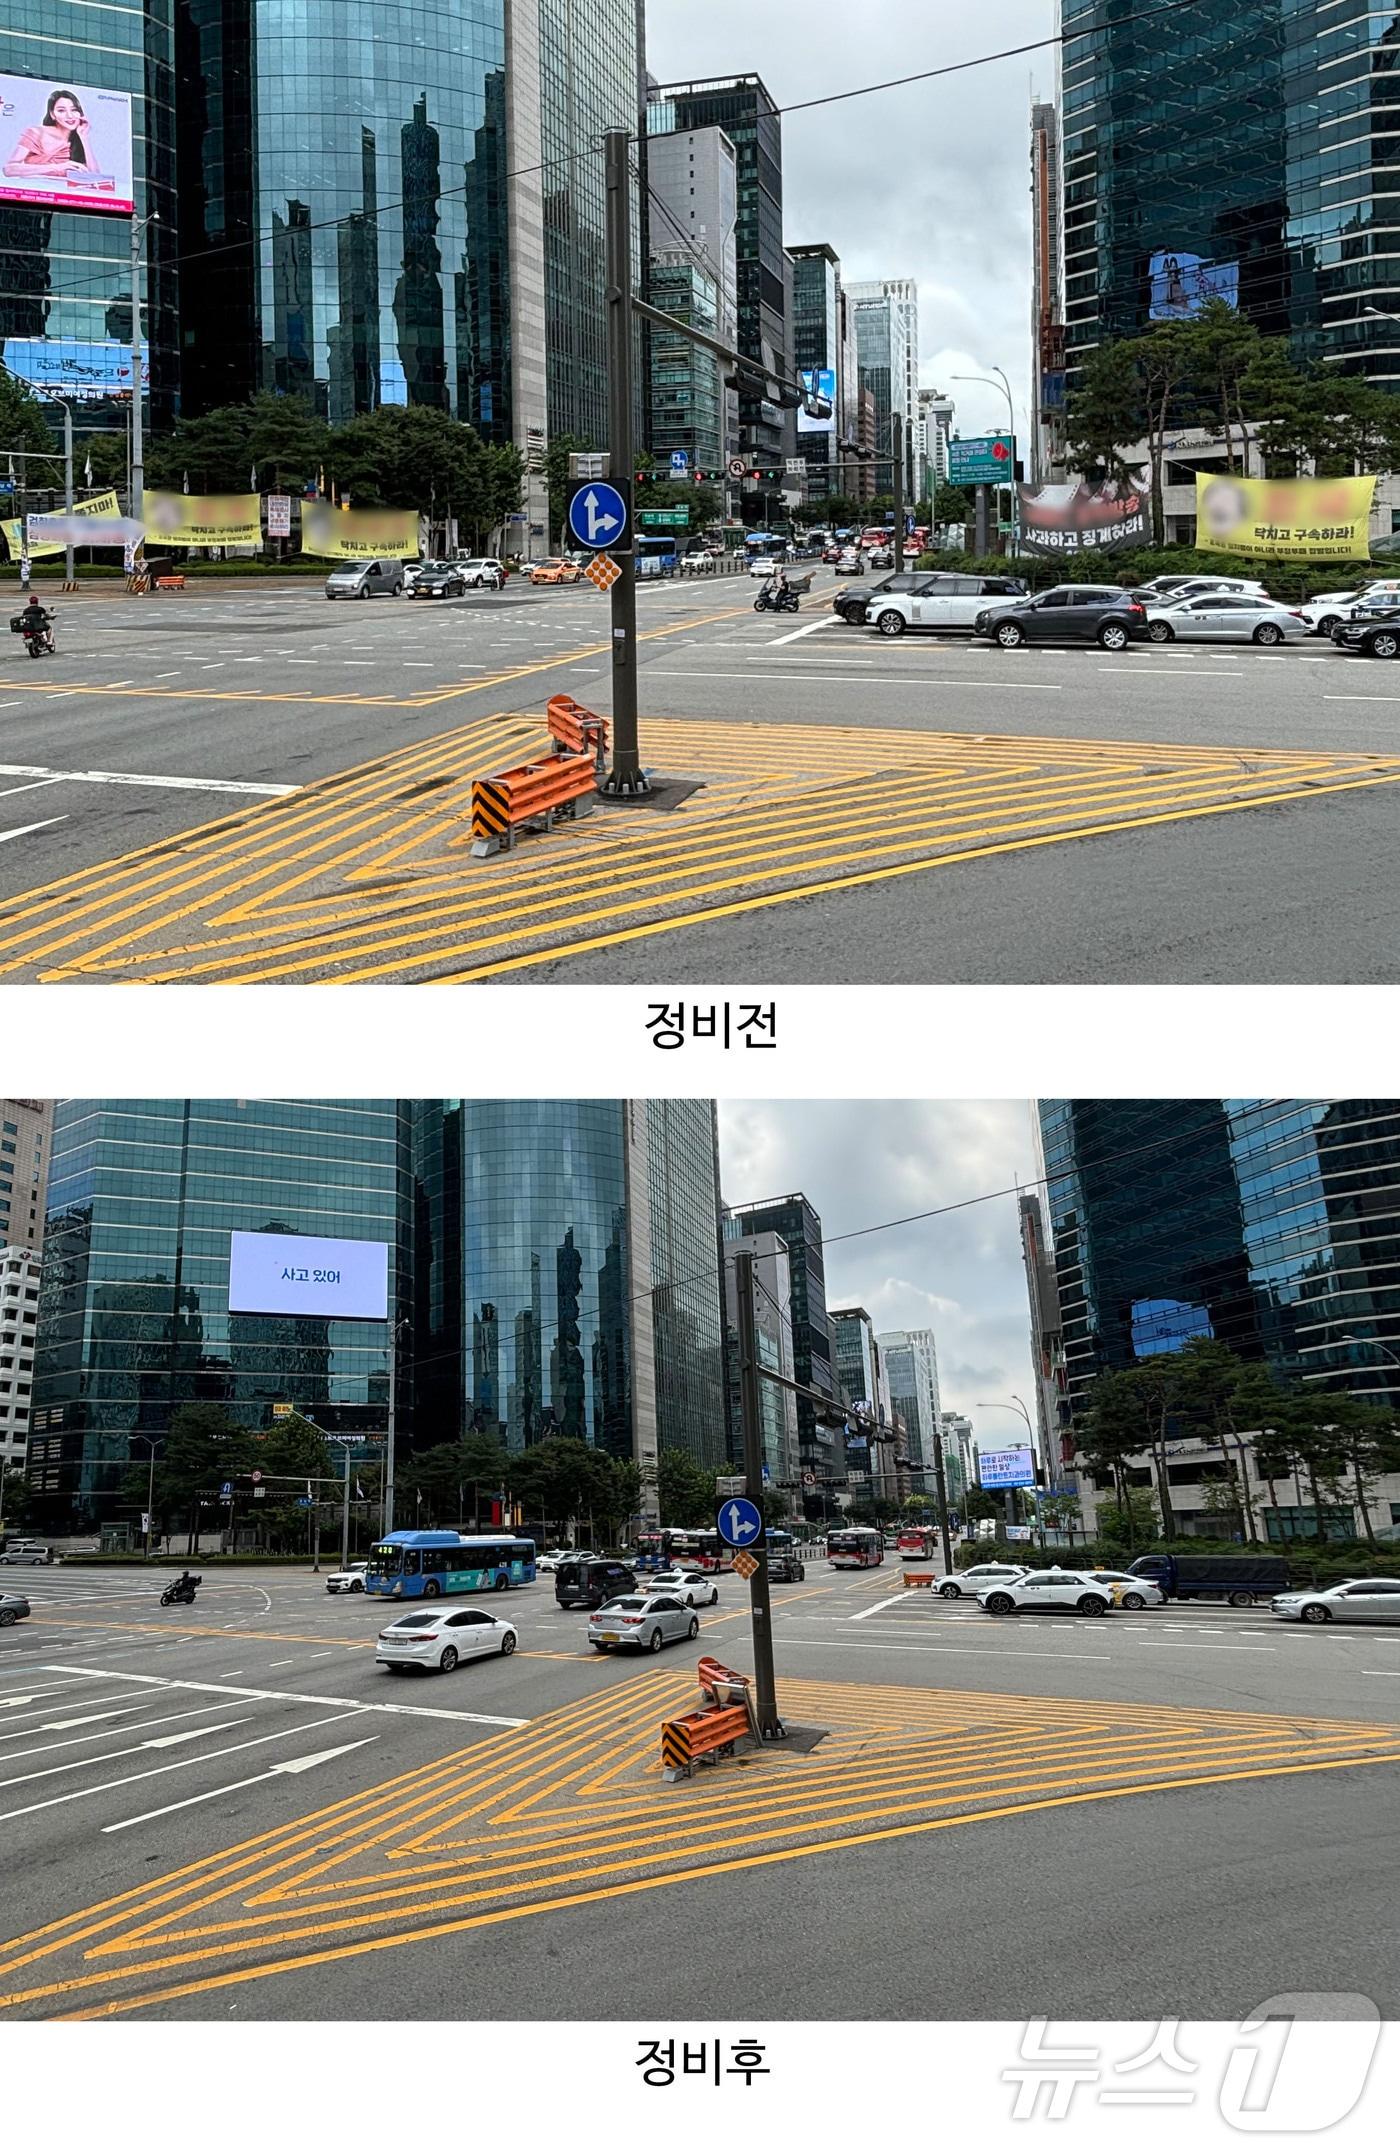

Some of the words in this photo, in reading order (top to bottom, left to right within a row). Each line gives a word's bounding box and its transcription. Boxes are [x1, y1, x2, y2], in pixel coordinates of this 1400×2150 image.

[1025, 526, 1079, 547] 사과하고
[1082, 514, 1144, 547] 징계하라!
[1254, 527, 1291, 541] 닥치고
[1294, 525, 1355, 541] 구속하라!
[281, 1267, 309, 1282] 사고
[312, 1269, 341, 1284] 있어
